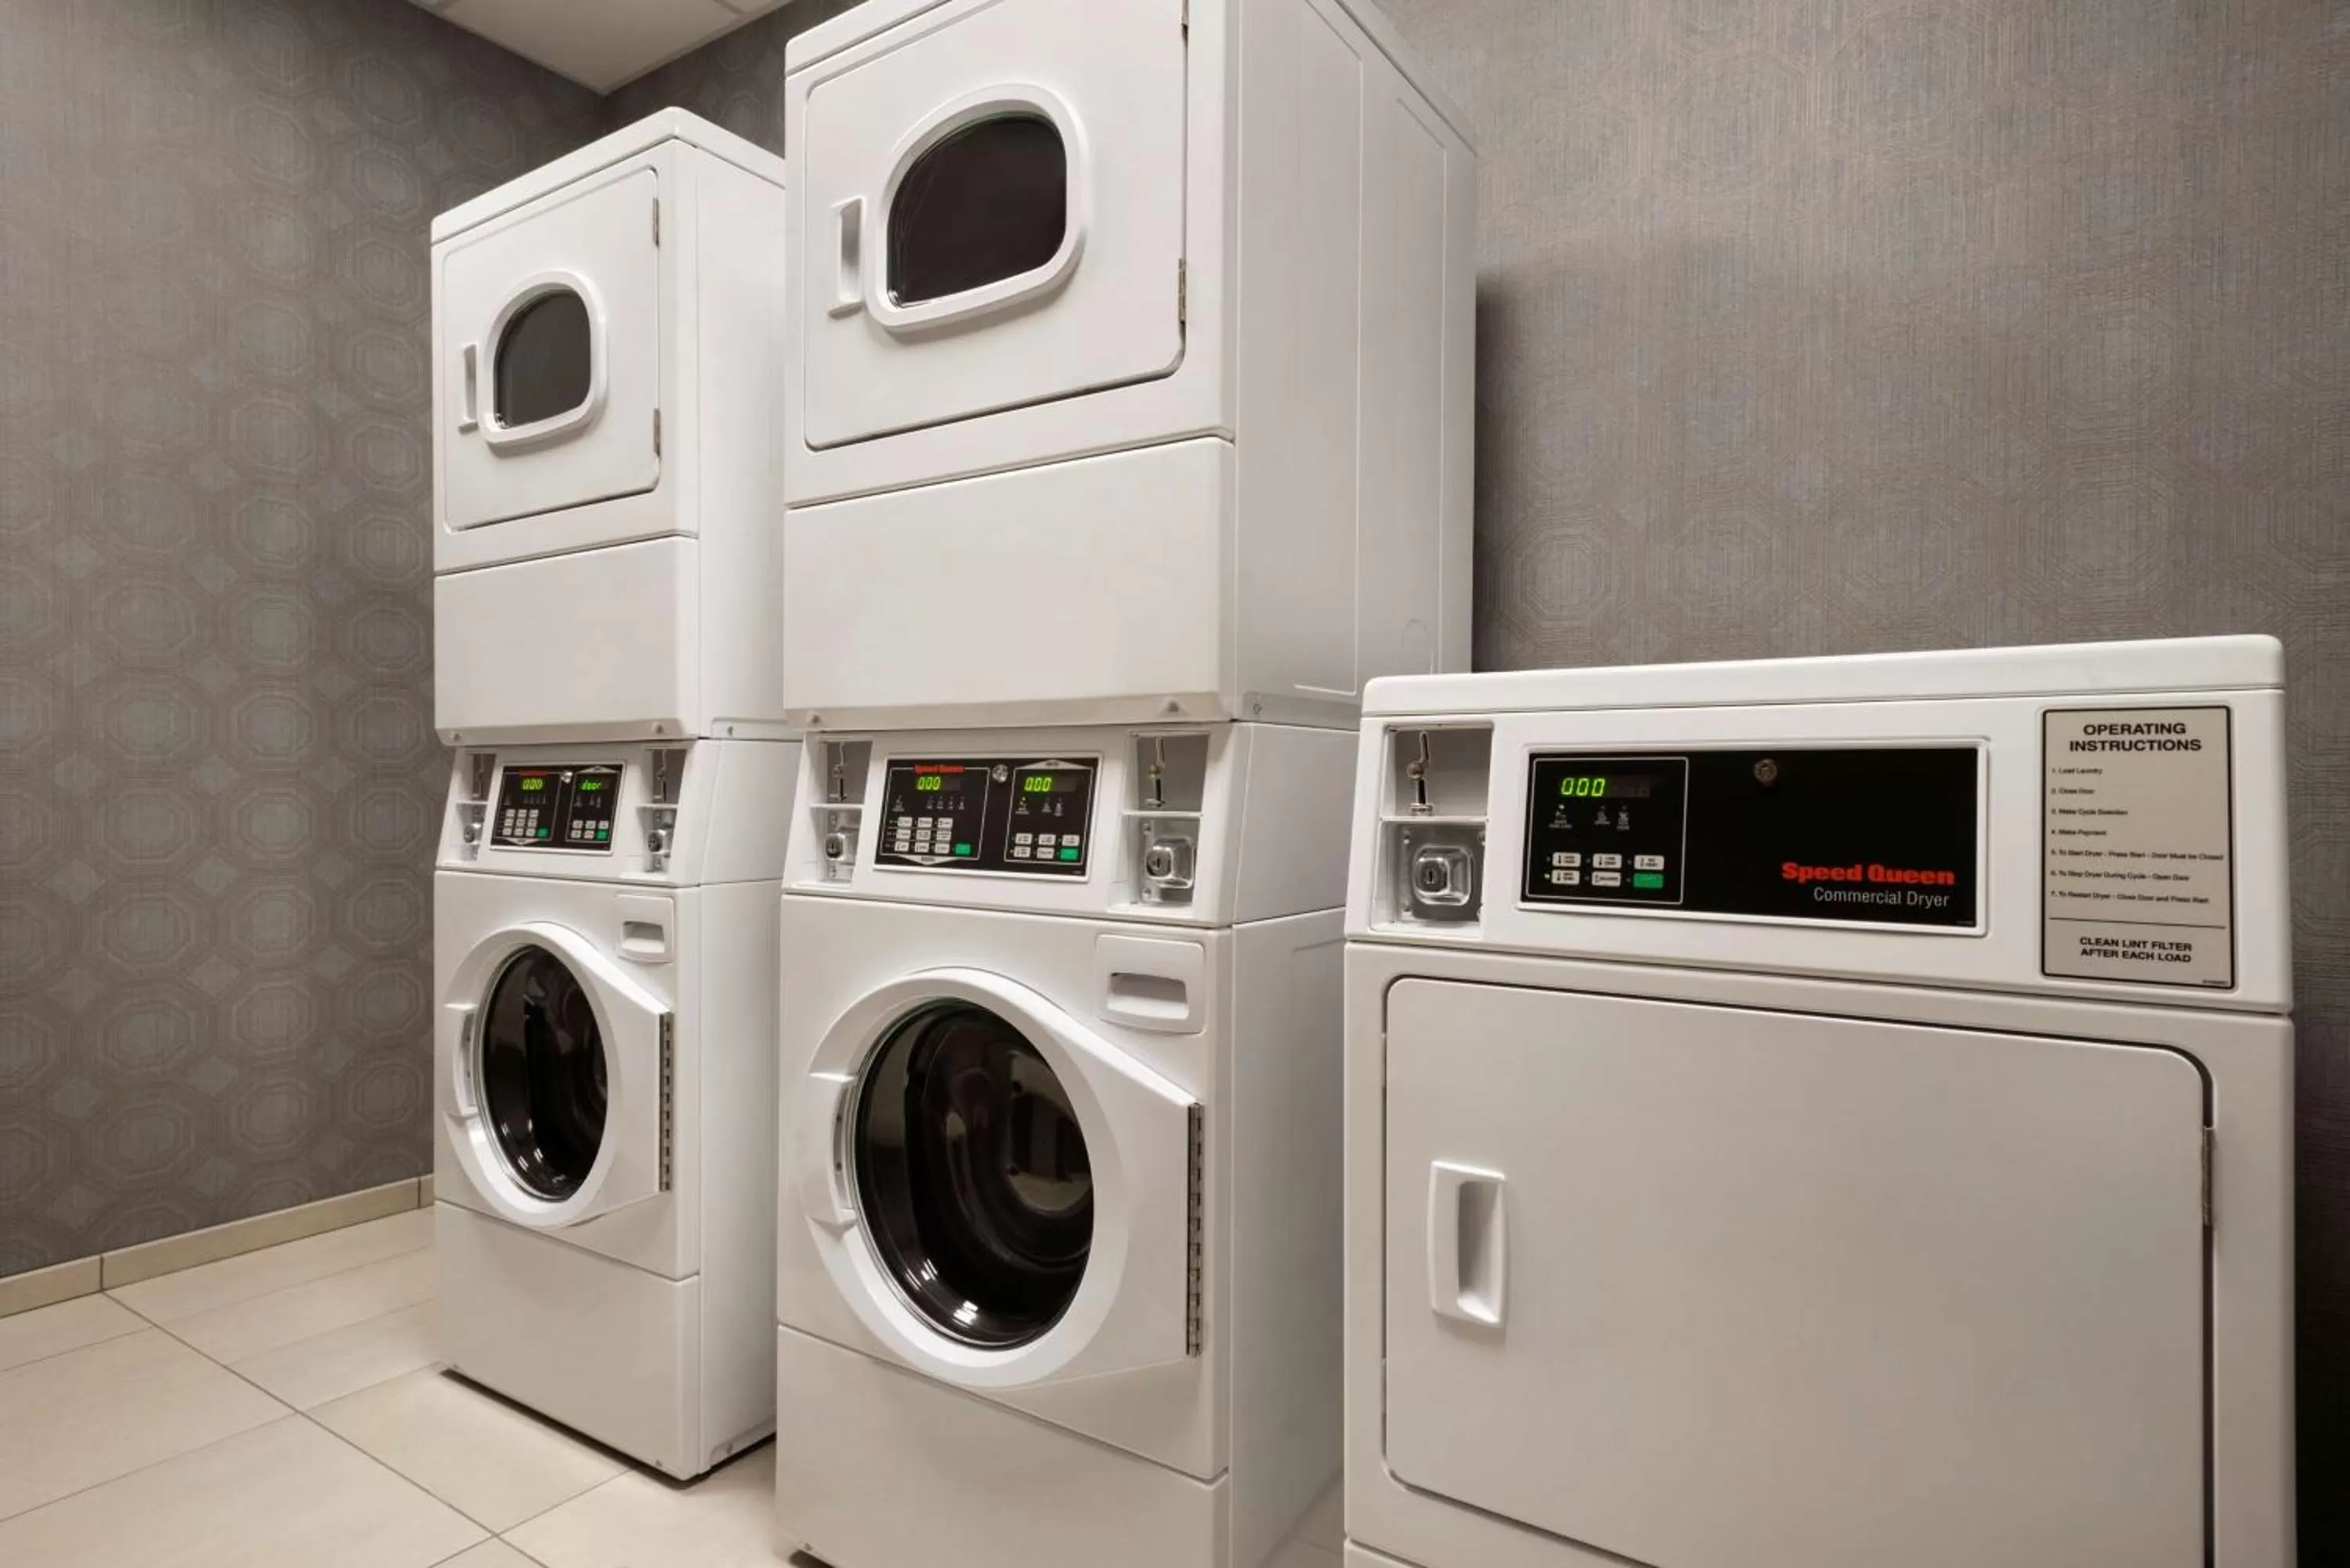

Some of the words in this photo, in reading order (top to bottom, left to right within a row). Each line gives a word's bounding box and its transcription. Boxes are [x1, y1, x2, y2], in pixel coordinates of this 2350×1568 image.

[2083, 722, 2186, 735] OPERATING
[2070, 739, 2202, 752] INSTRUCTIONS
[1561, 777, 1606, 797] 000
[1781, 862, 1863, 884] Speed
[1867, 864, 1955, 885] Queen
[1813, 886, 1902, 905] Commercial
[1907, 891, 1949, 909] Dryer
[2080, 937, 2119, 947] CLEAN
[2122, 939, 2149, 949] LINT
[2152, 941, 2193, 952] FILTER
[2081, 948, 2119, 959] AFTER
[2121, 950, 2155, 961] EACH
[2157, 952, 2192, 963] LOAD
